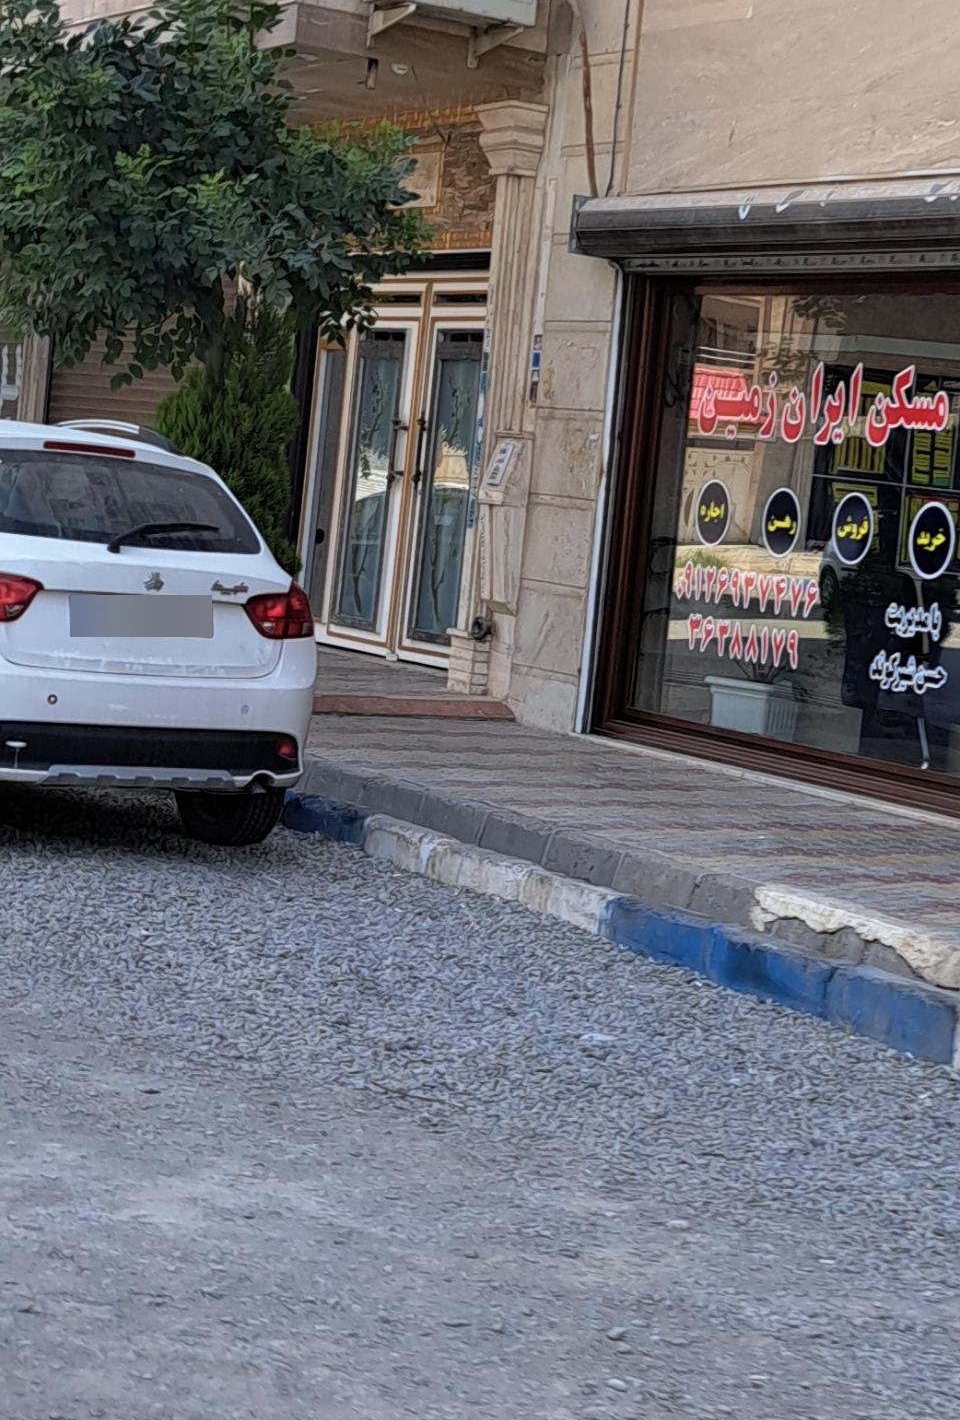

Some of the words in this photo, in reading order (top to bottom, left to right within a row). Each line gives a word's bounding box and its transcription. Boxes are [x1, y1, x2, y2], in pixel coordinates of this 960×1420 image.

[697, 370, 778, 440] زمین
[781, 361, 864, 445] ایران
[865, 364, 949, 447] مسکن
[700, 502, 725, 523] اجاره
[767, 515, 797, 535] رهن
[837, 515, 869, 540] فروش
[916, 527, 946, 552] خرید
